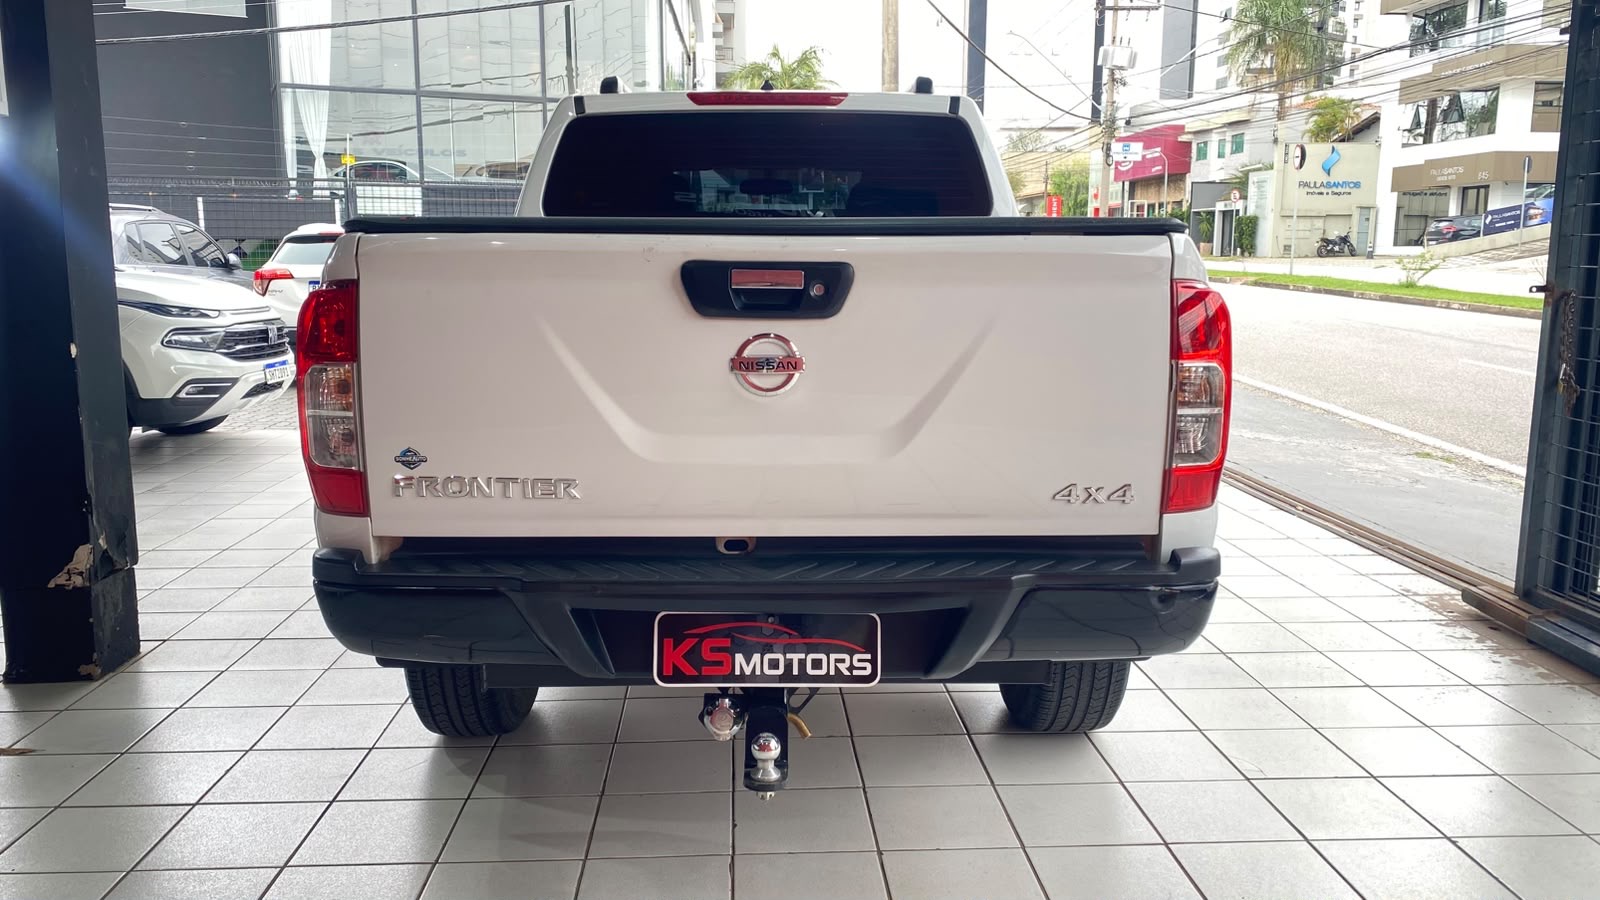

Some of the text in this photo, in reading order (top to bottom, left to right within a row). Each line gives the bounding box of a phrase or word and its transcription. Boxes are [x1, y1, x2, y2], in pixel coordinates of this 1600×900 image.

[738, 361, 798, 371] NISSAN
[392, 474, 582, 500] FRONTIER
[1052, 483, 1135, 504] 4x4
[663, 638, 872, 676] KS MOTORS
